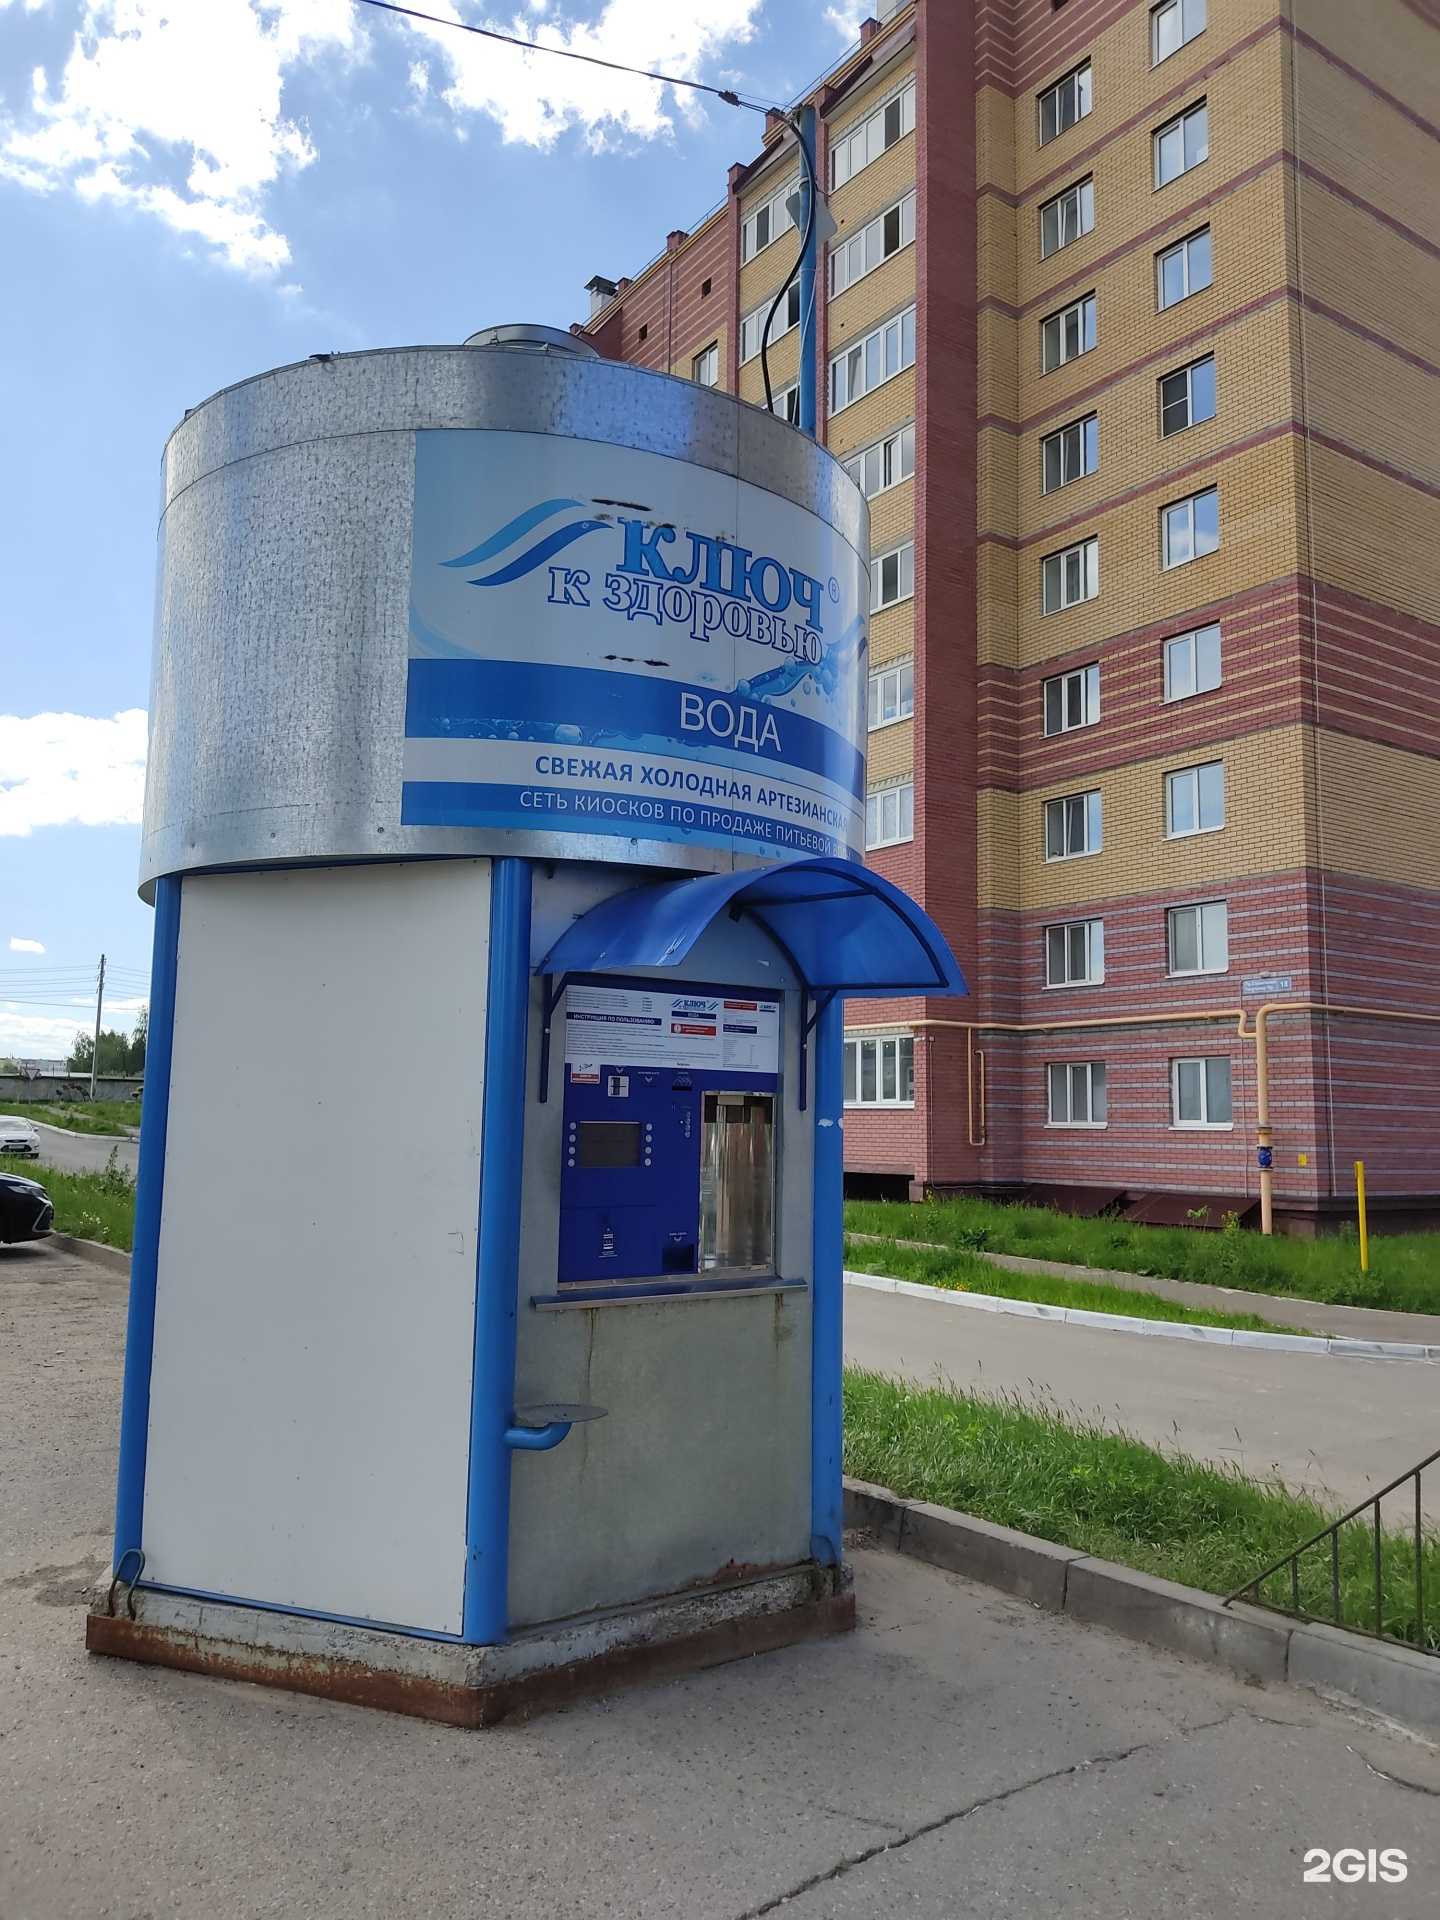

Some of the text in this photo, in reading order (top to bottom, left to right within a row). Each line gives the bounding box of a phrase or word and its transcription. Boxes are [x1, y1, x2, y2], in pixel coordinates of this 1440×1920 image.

[615, 516, 825, 633] КЛЮЧ
[680, 692, 783, 753] ВОДА
[535, 755, 633, 782] СВЕЖАЯ
[640, 766, 751, 802] ХОЛОДНАЯ
[520, 791, 568, 810] СЕТЬ
[575, 795, 664, 820] КИОСКОВ
[670, 806, 696, 824] ПО
[700, 810, 772, 838] ПРОДАЖЕ
[775, 825, 831, 856] ПИТЬЕВОЙ
